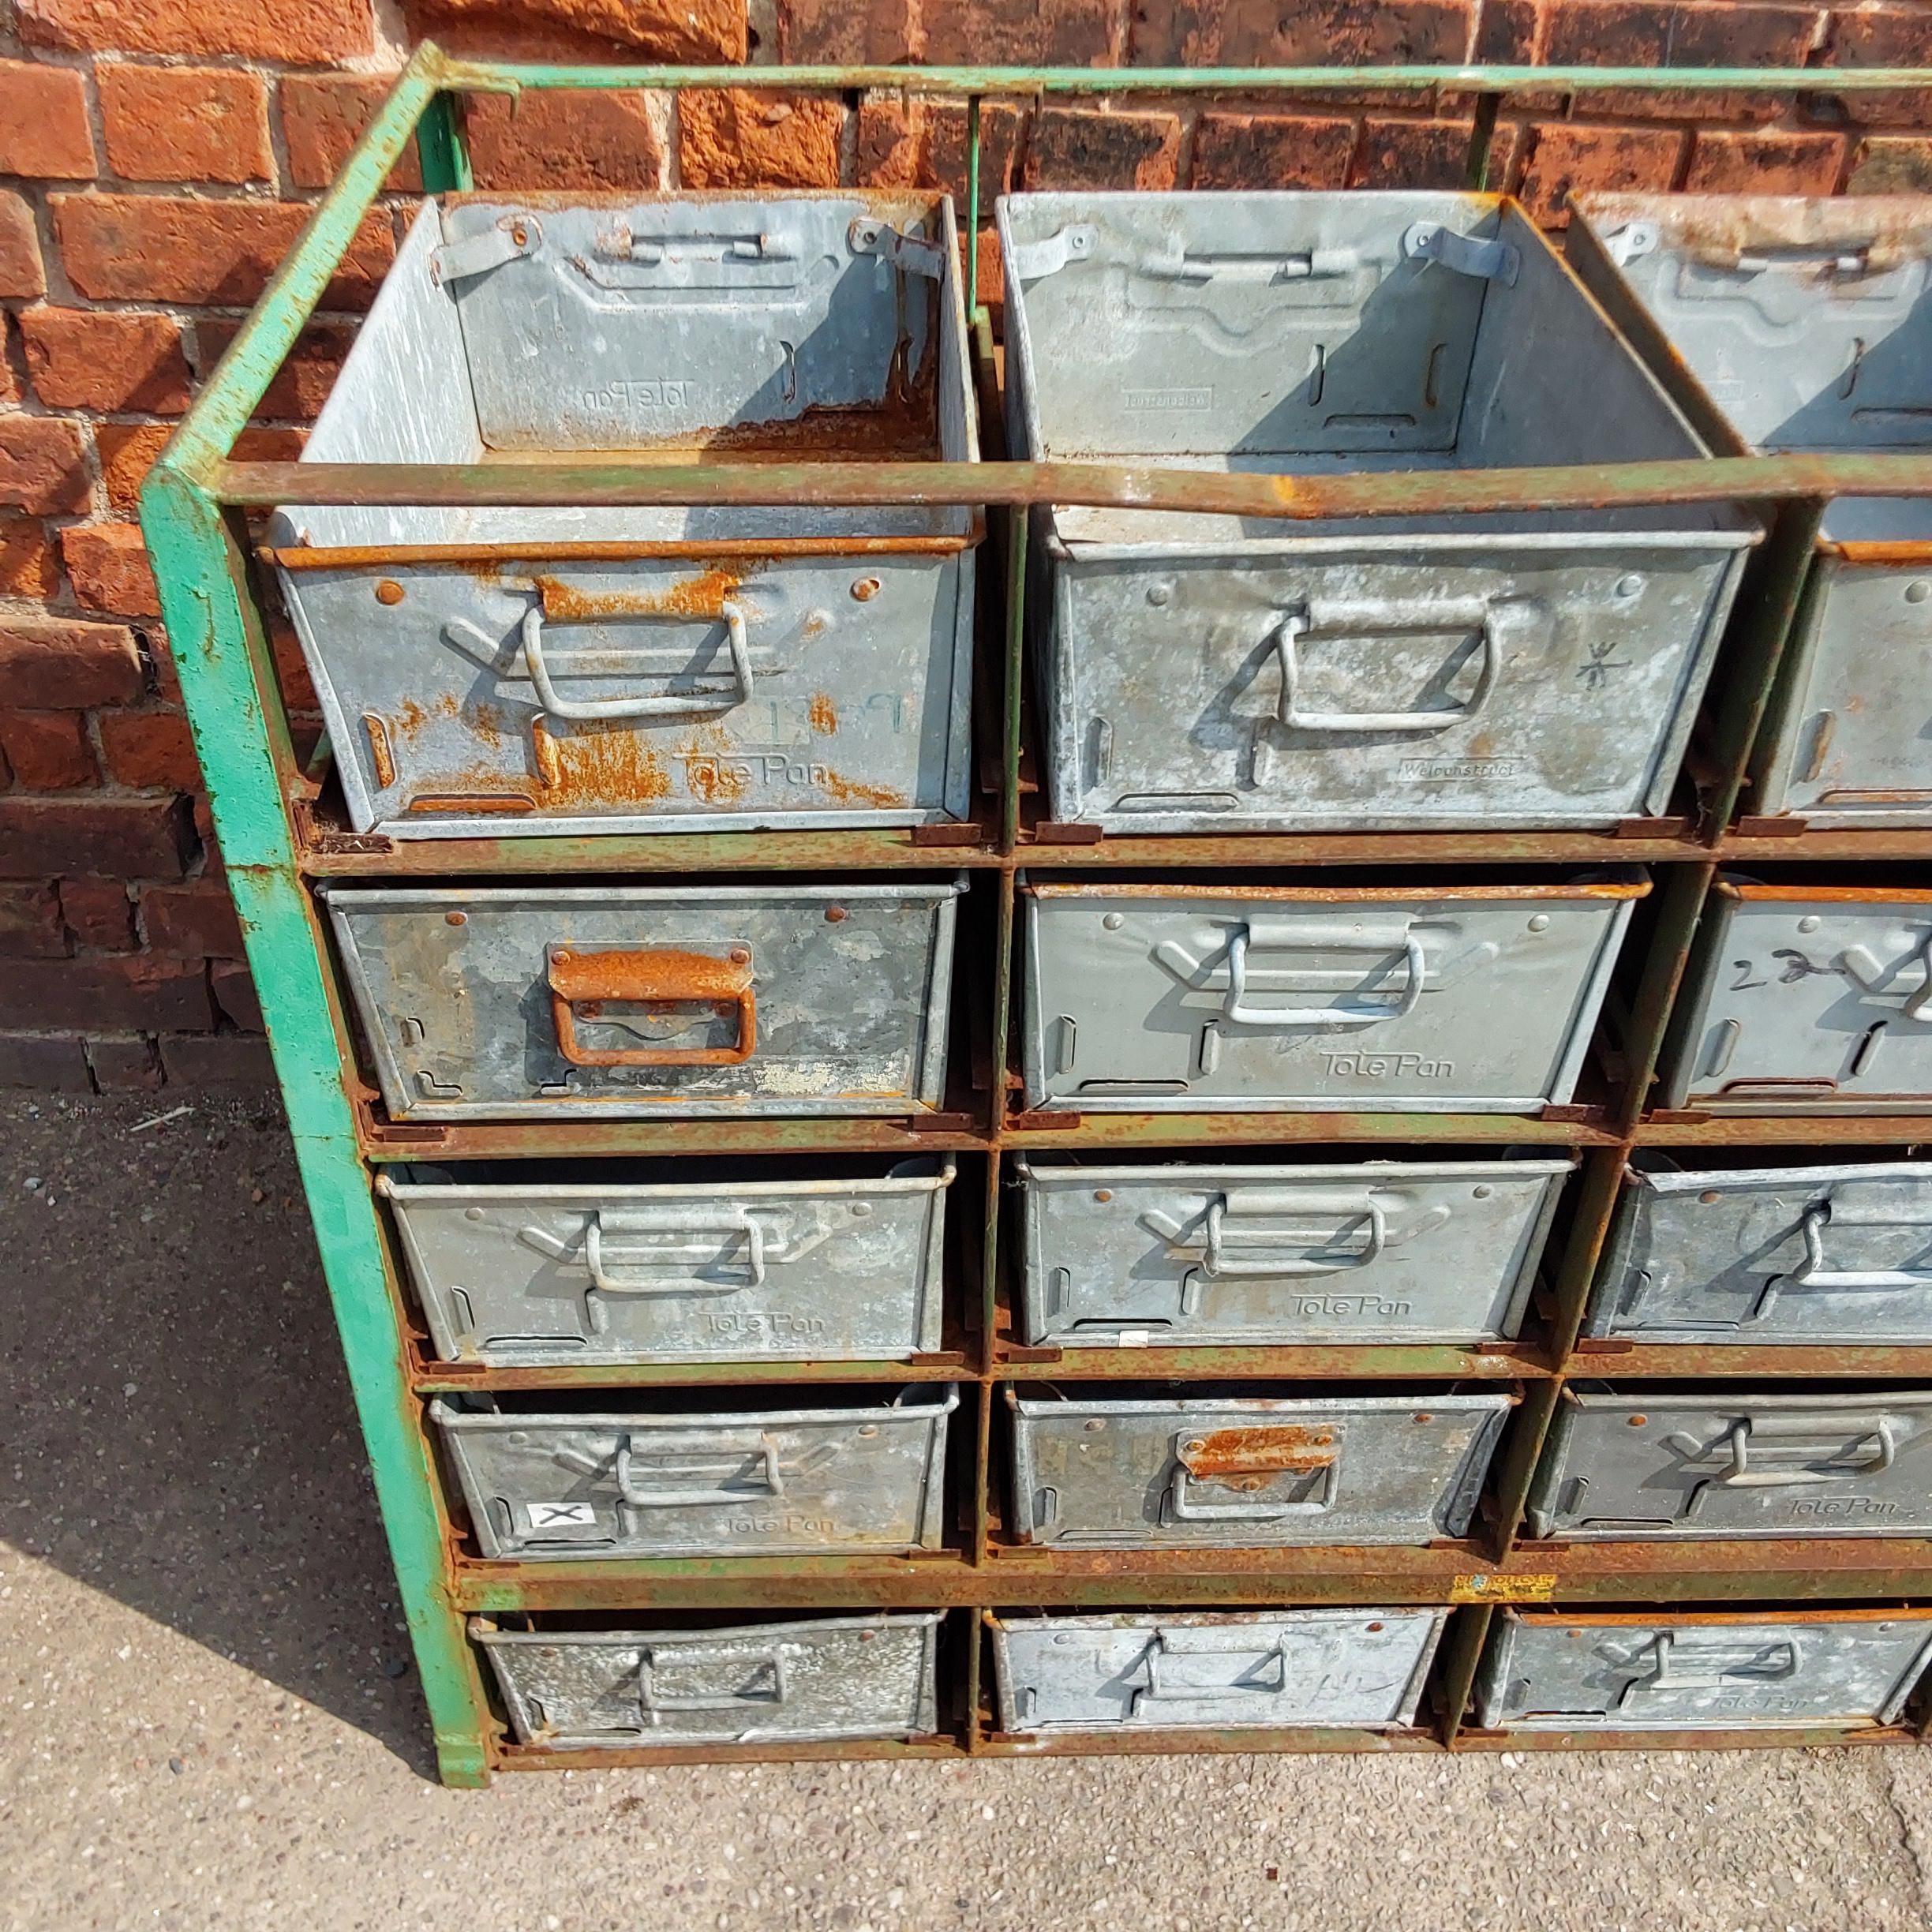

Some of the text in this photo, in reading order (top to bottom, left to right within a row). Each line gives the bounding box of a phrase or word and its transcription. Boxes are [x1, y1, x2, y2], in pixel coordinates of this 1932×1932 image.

[672, 751, 829, 787] Tote Pan
[1320, 1050, 1455, 1078] Tote Pan
[1290, 1293, 1413, 1316] Tote Pan
[698, 1309, 826, 1333] Tote Pan
[1790, 1494, 1900, 1515] Tote Pan
[724, 1514, 834, 1533] Tote Pan
